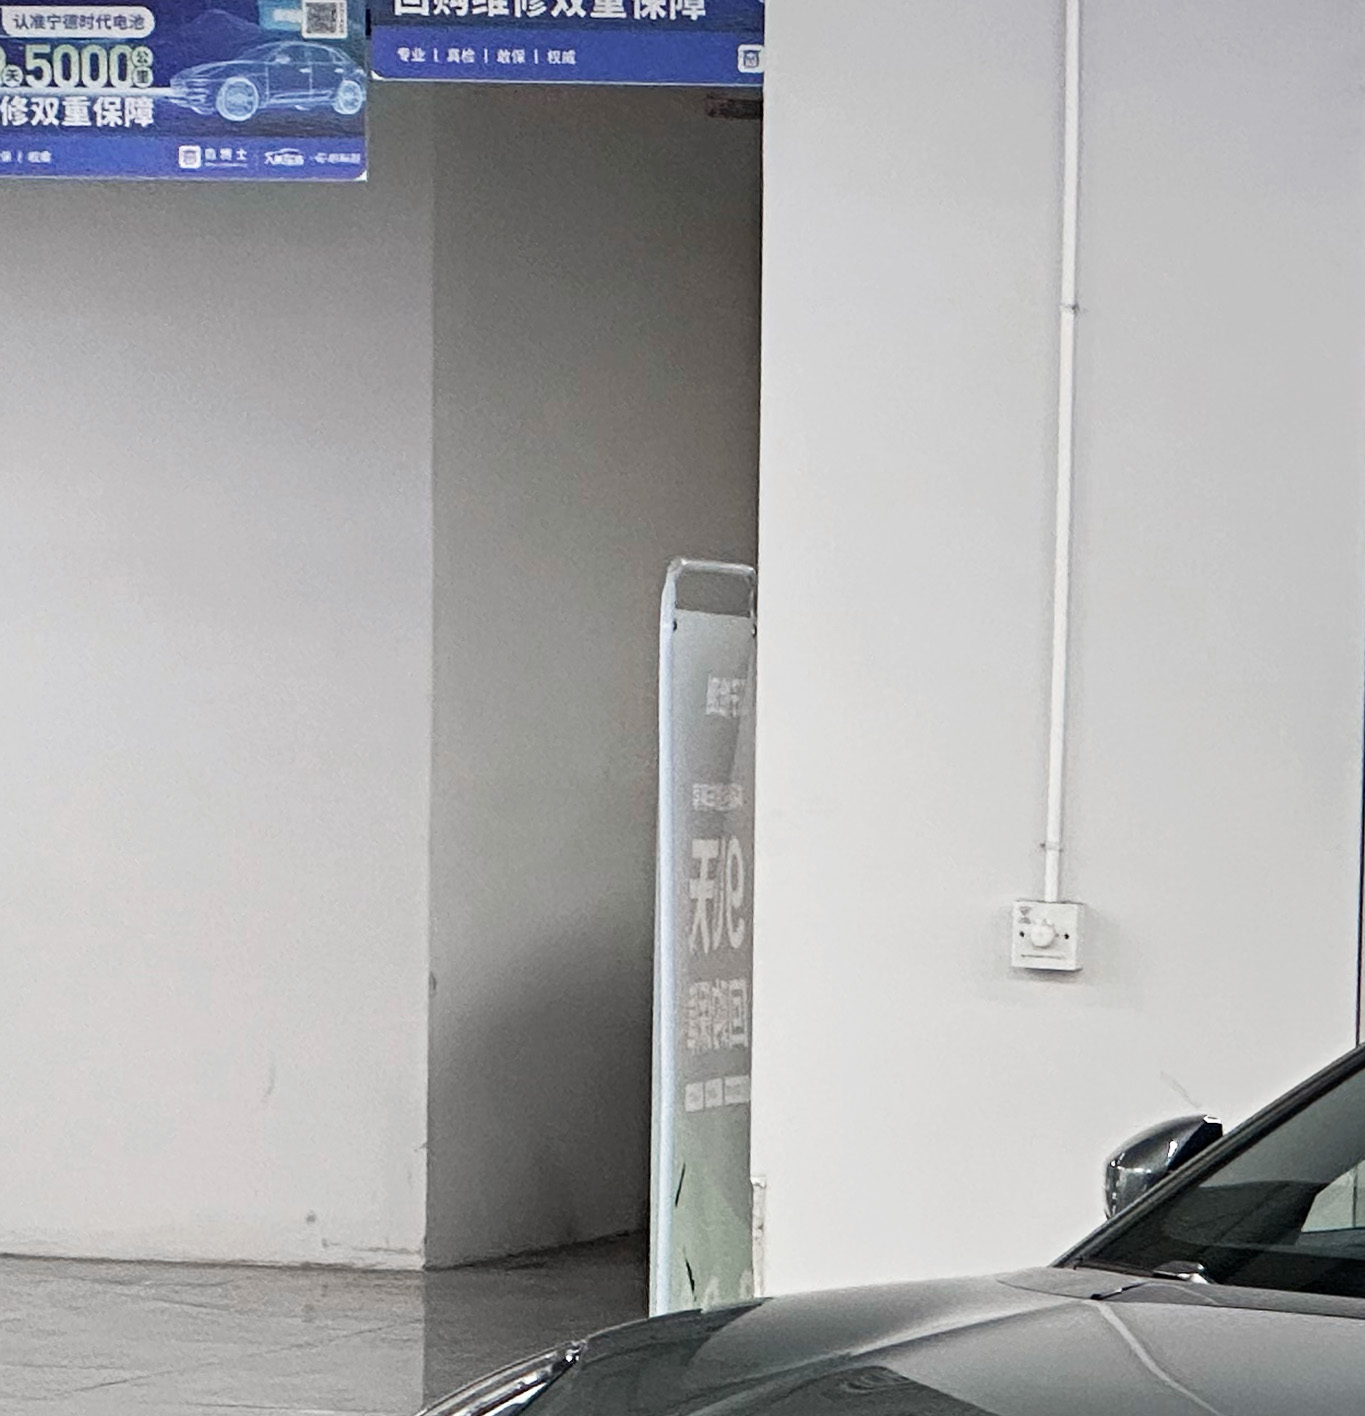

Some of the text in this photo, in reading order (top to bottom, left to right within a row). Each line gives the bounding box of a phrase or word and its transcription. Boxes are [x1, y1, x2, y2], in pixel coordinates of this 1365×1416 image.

[13, 14, 145, 30] 认准宁德时代电池
[0, 95, 154, 127] 修双重保障
